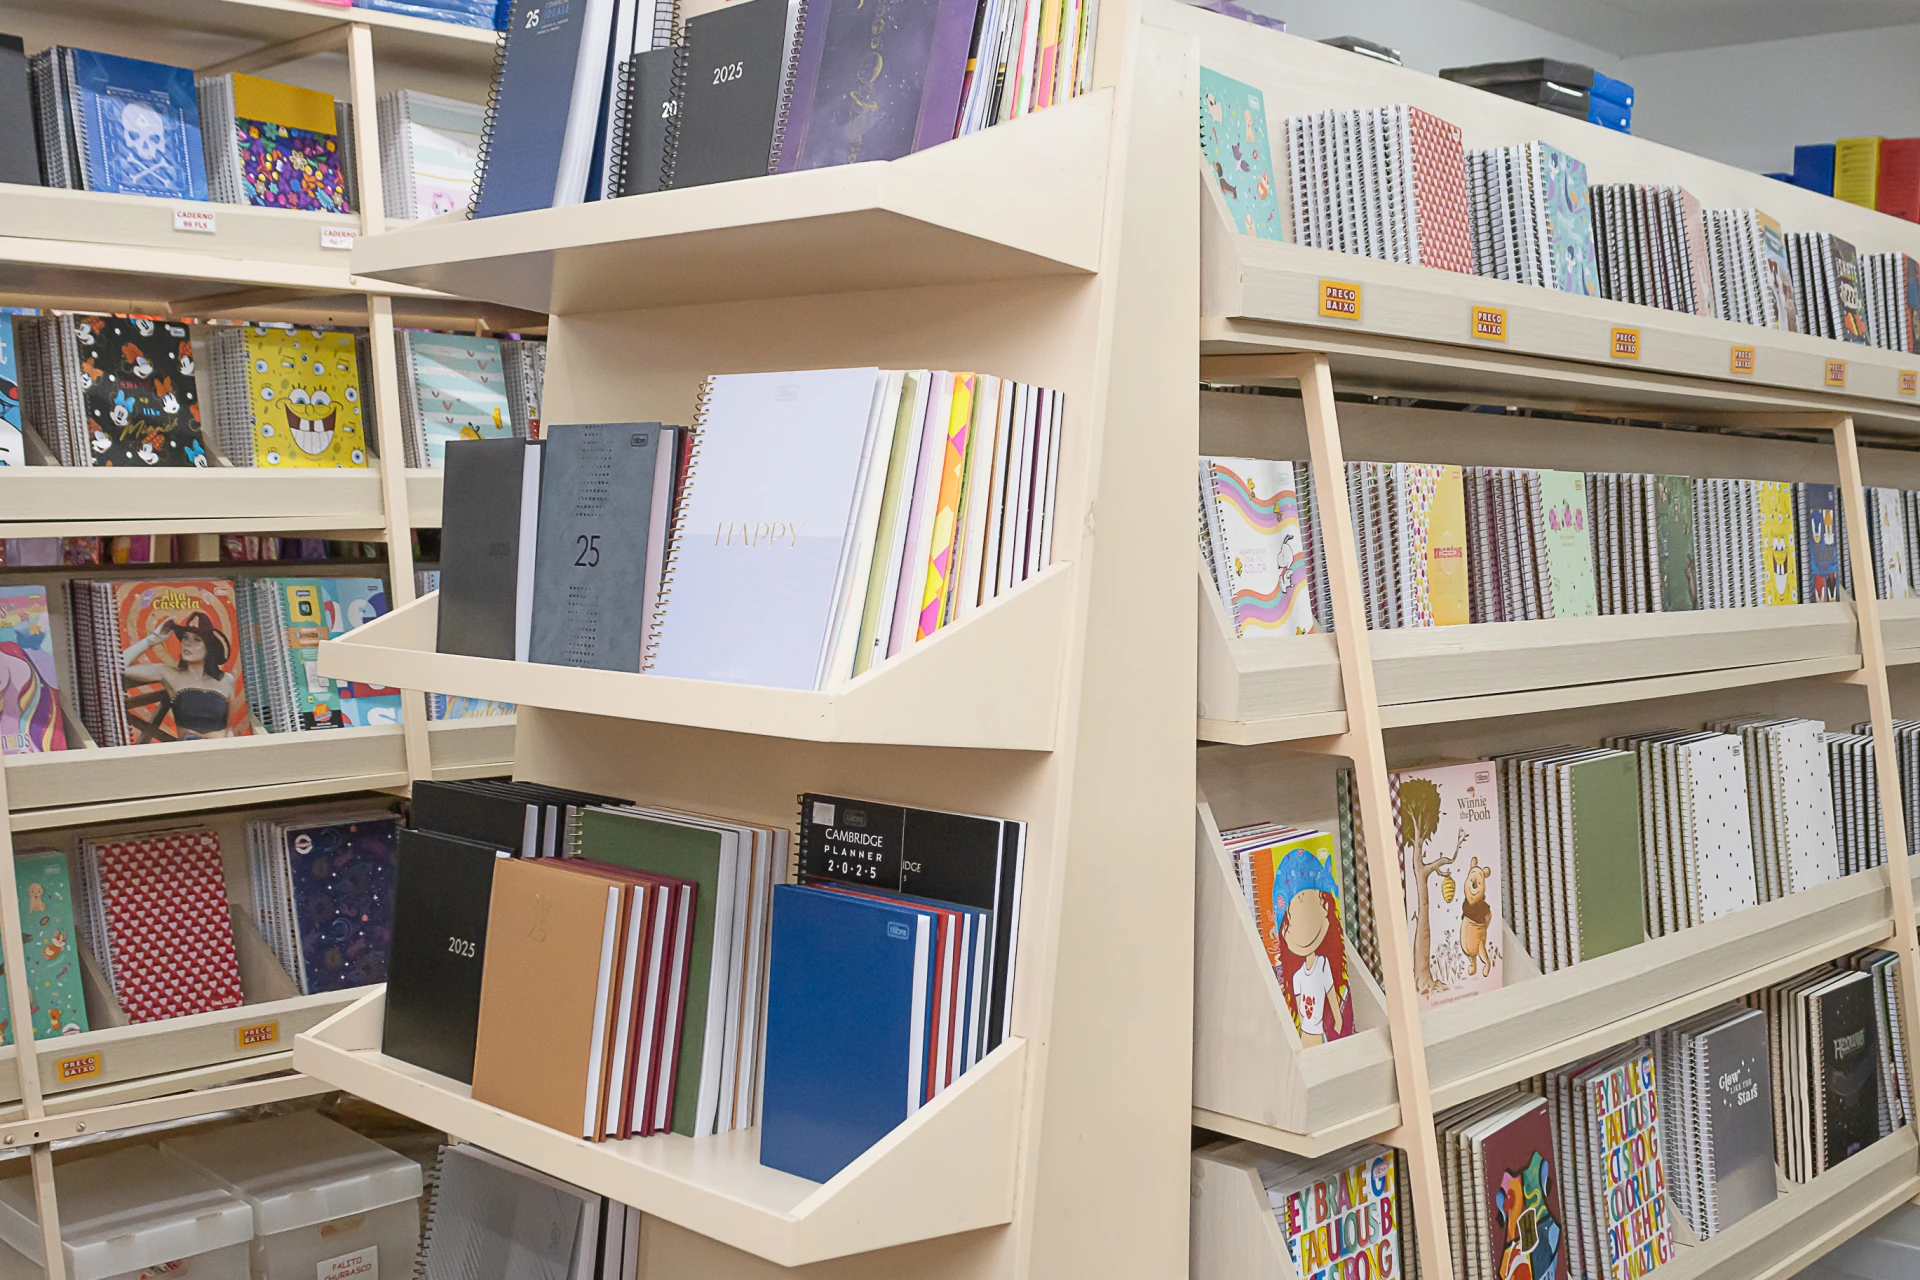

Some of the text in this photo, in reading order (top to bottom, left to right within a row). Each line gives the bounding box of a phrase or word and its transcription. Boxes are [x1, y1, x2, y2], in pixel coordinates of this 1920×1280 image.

[525, 9, 540, 29] 25
[712, 61, 743, 85] 2025
[176, 210, 214, 220] CADERNO
[194, 221, 208, 229] FLS
[323, 229, 357, 239] CADERNO
[1326, 287, 1356, 300] PREÇO
[1326, 300, 1356, 313] BAIXO
[1478, 312, 1502, 323] PREÇO
[1478, 323, 1502, 335] BAIXO
[142, 408, 161, 416] like
[714, 522, 806, 547] HAPPY
[574, 534, 600, 567] 25
[1243, 563, 1268, 574] COLOR
[161, 589, 187, 602] Ana
[152, 598, 200, 610] Castela
[1457, 795, 1487, 810] Winnie
[1468, 807, 1491, 822] Pooh
[825, 828, 884, 848] CAMBRIDGE
[824, 845, 883, 862] PLANNER
[448, 936, 476, 958] 2025
[244, 1034, 272, 1044] BAIXO
[64, 1065, 95, 1077] BAIXO
[1611, 1060, 1641, 1108] BRAVE
[1718, 1069, 1741, 1092] Glow
[1737, 1083, 1758, 1106] Stars
[1605, 1093, 1649, 1151] FABULOUS
[1314, 1163, 1368, 1225] BRAVE
[1300, 1202, 1380, 1276] FABULOUS
[332, 1256, 363, 1271] PALITO
